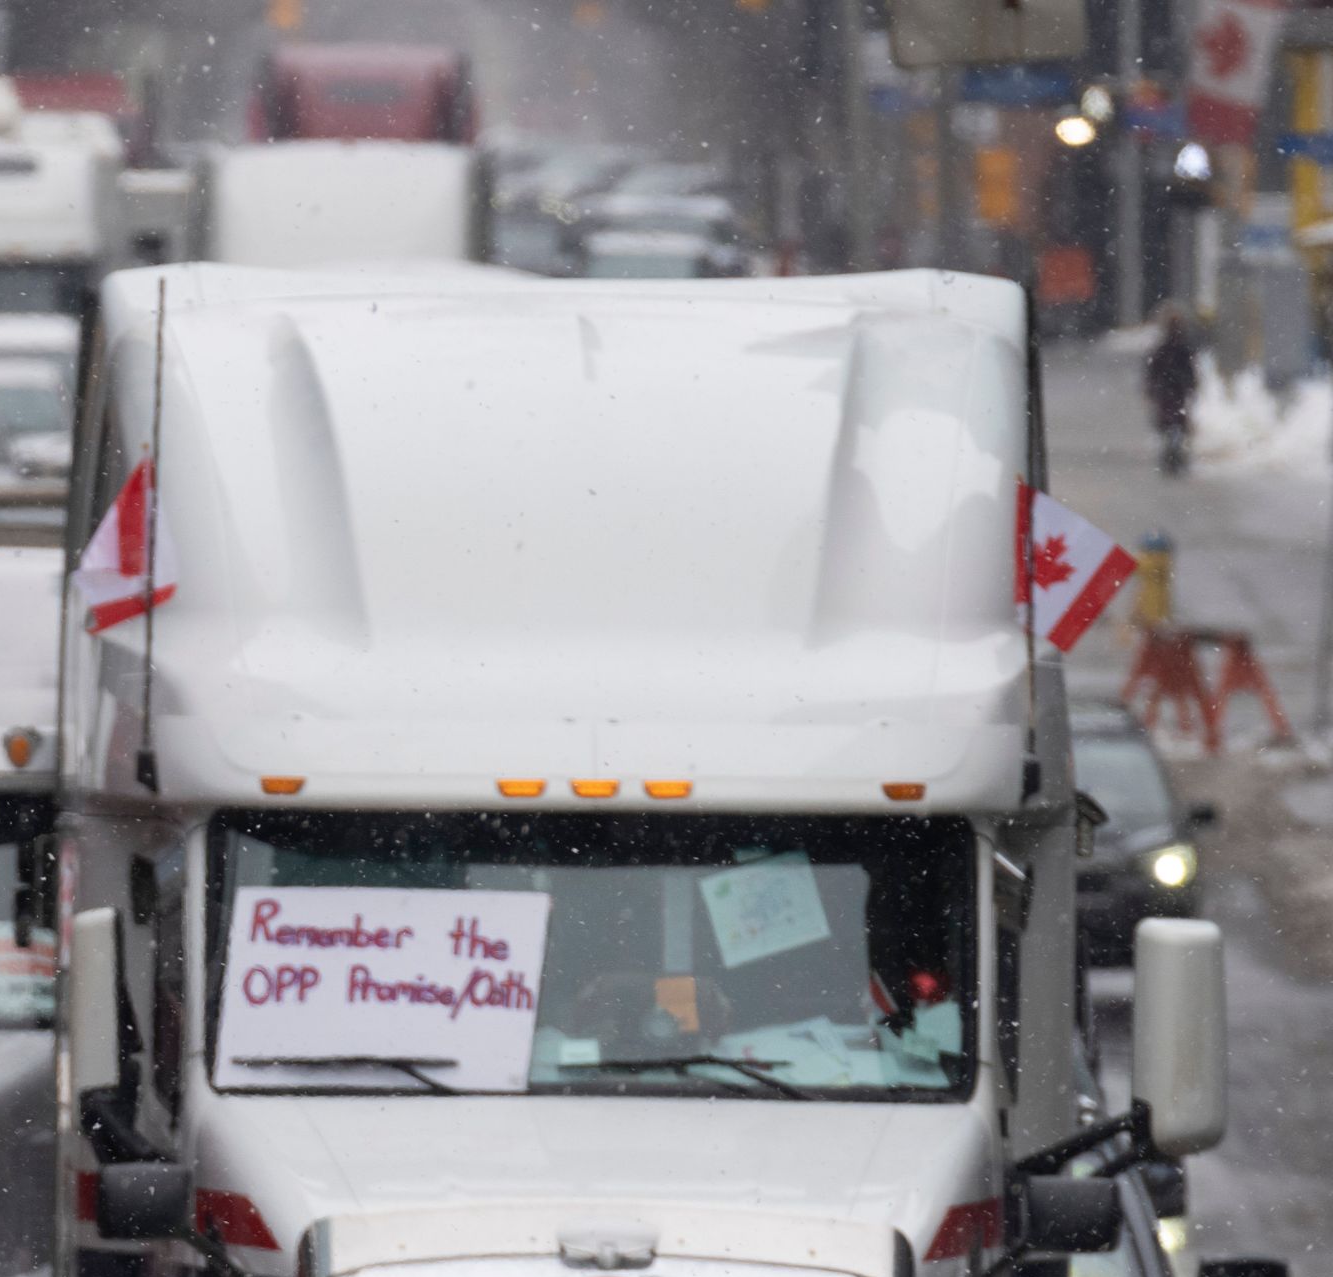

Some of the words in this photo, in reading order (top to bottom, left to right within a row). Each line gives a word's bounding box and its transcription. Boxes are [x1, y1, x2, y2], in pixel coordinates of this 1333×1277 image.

[250, 899, 413, 948] Remember
[449, 915, 509, 960] the
[242, 965, 321, 1006] OPP
